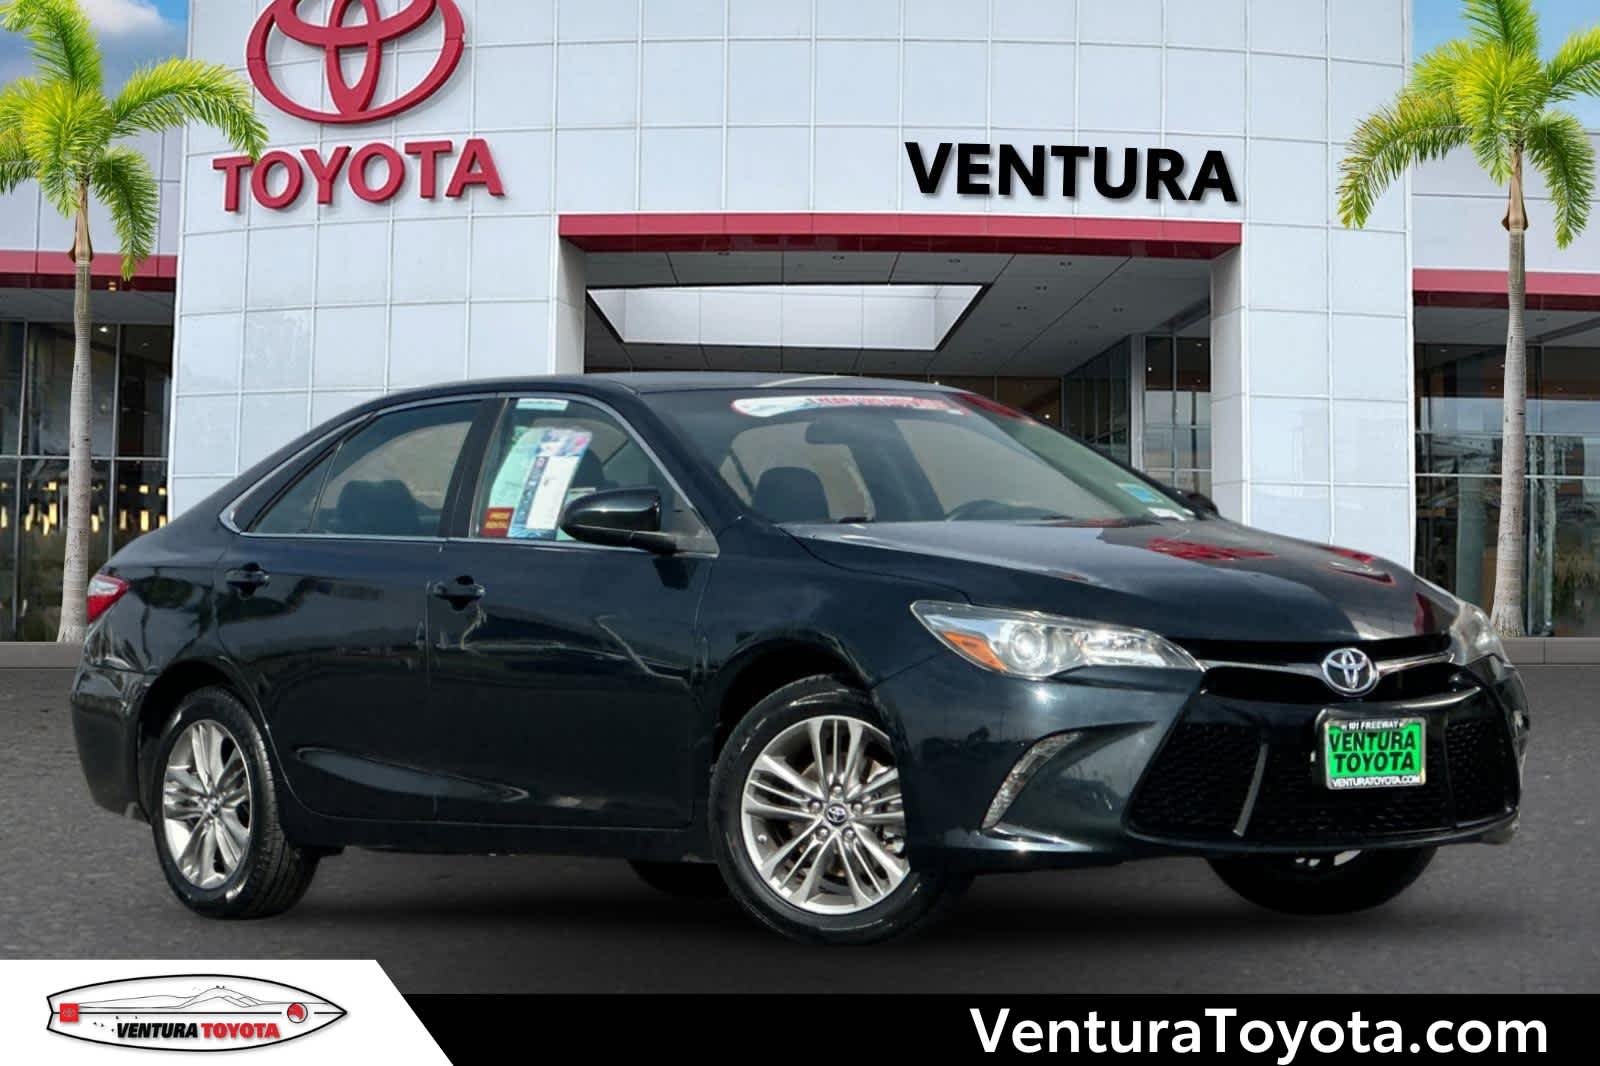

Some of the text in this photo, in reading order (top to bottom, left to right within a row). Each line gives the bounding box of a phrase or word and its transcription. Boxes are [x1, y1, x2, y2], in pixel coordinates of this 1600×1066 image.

[213, 138, 505, 212] TOYOTA
[904, 141, 1239, 203] VENTURA
[1348, 720, 1359, 730] 101
[1360, 720, 1399, 730] FREEWAY
[1329, 730, 1415, 752] VENTURA
[1333, 751, 1415, 773] TOYOTA
[1332, 775, 1420, 787] VENTURATOYOTA.COM
